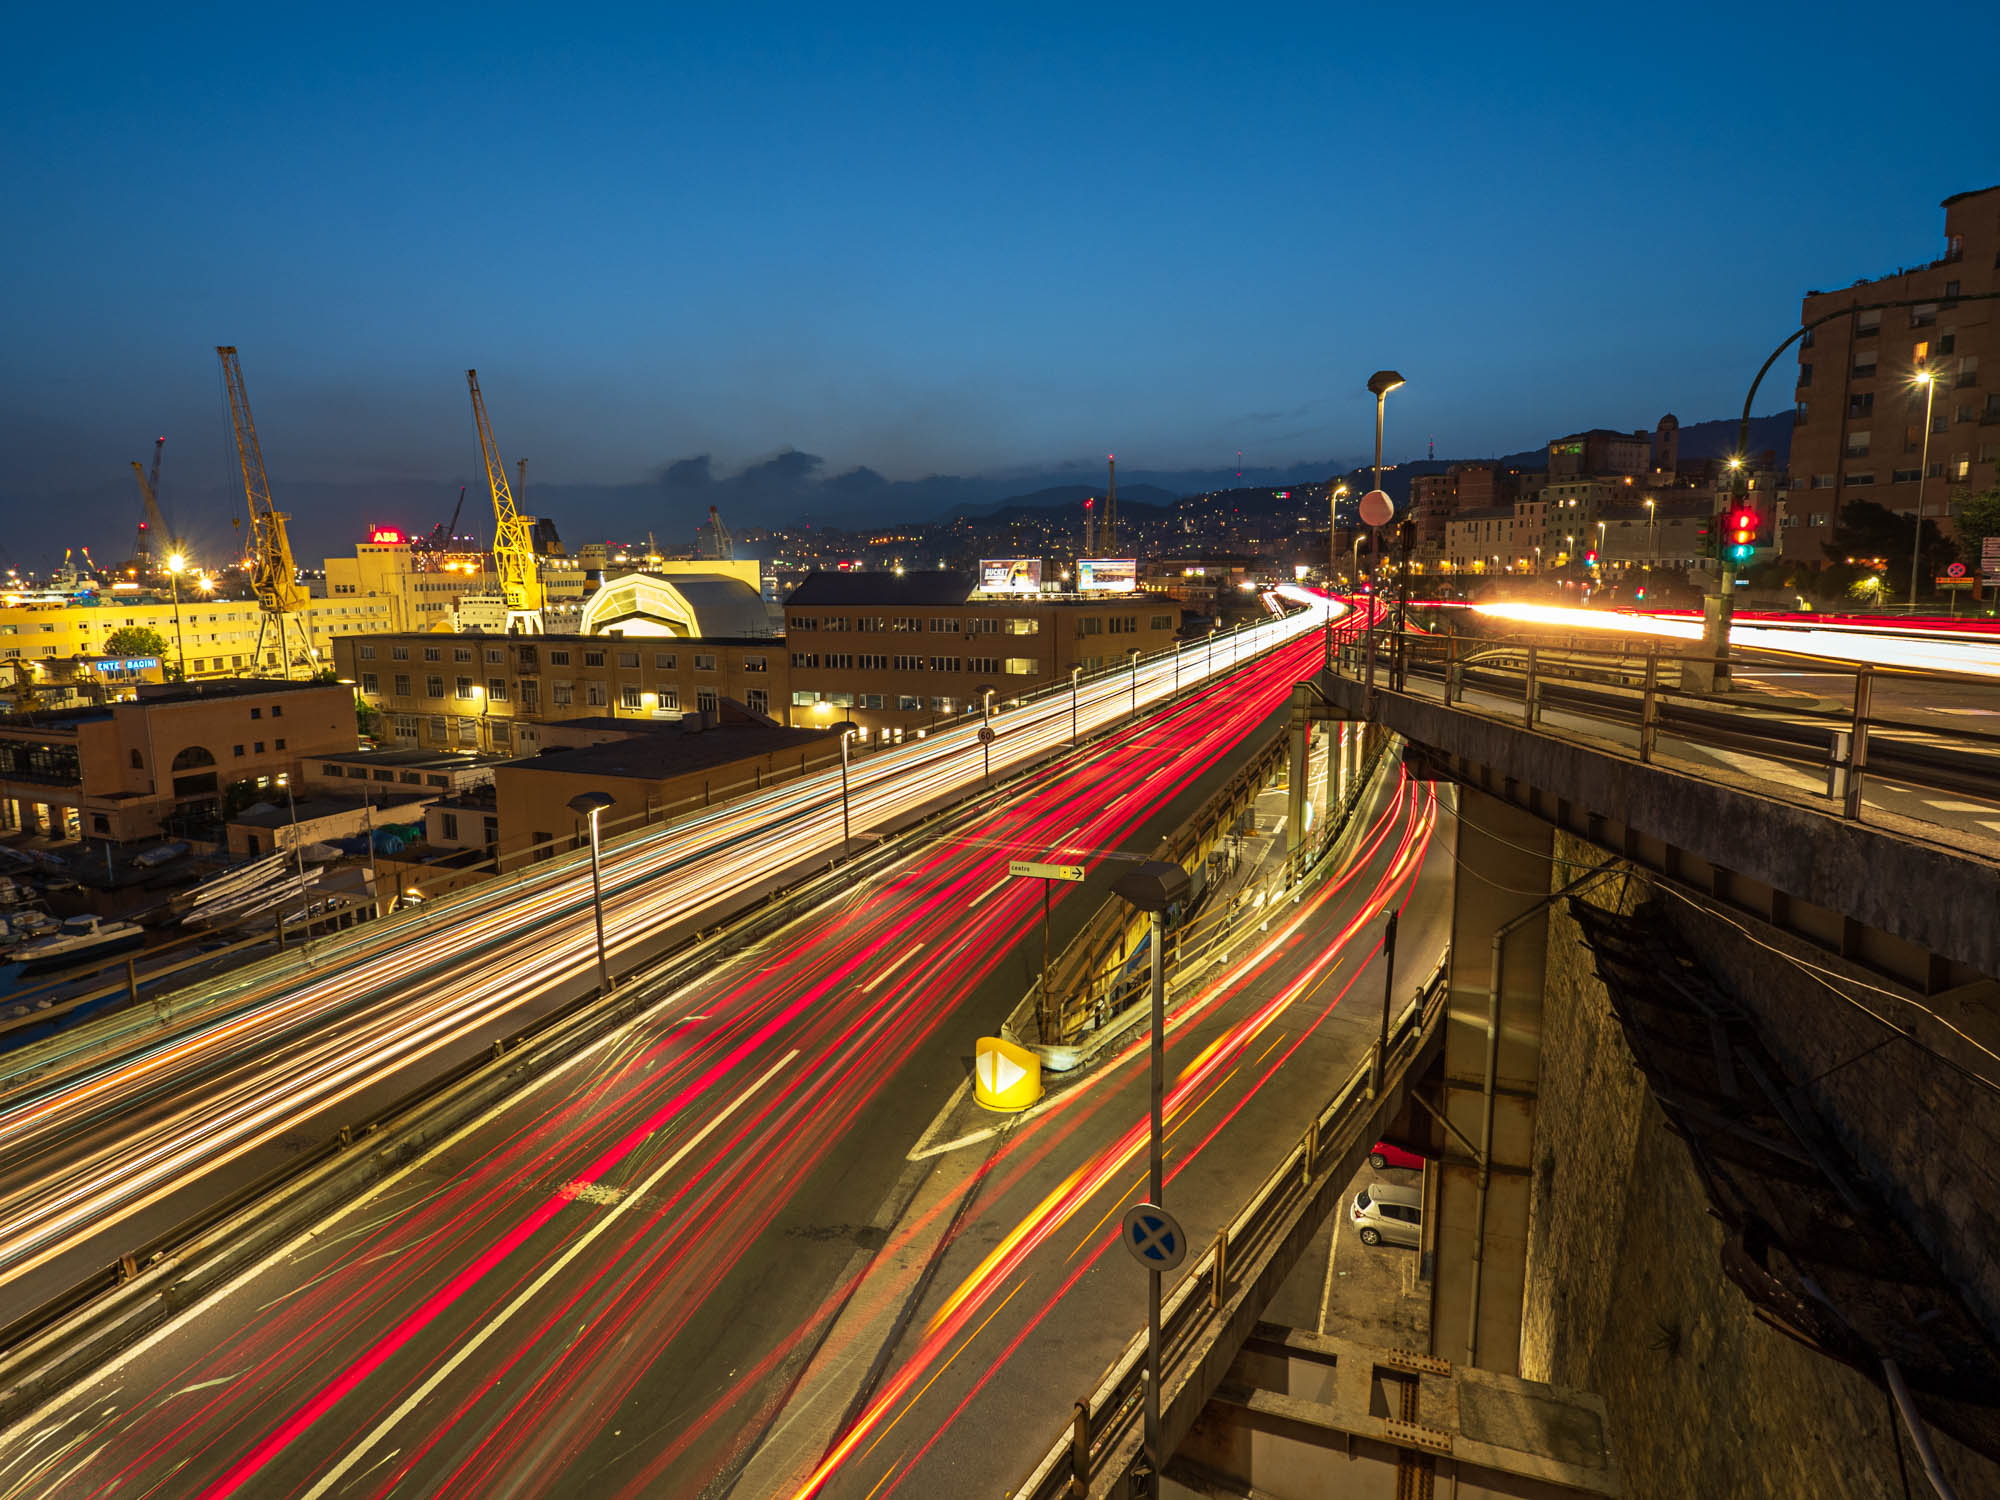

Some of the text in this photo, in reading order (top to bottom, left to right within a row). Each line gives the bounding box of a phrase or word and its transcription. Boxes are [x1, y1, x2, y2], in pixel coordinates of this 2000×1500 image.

[374, 531, 398, 543] ABB
[97, 662, 120, 671] ENTE
[980, 731, 991, 740] 60
